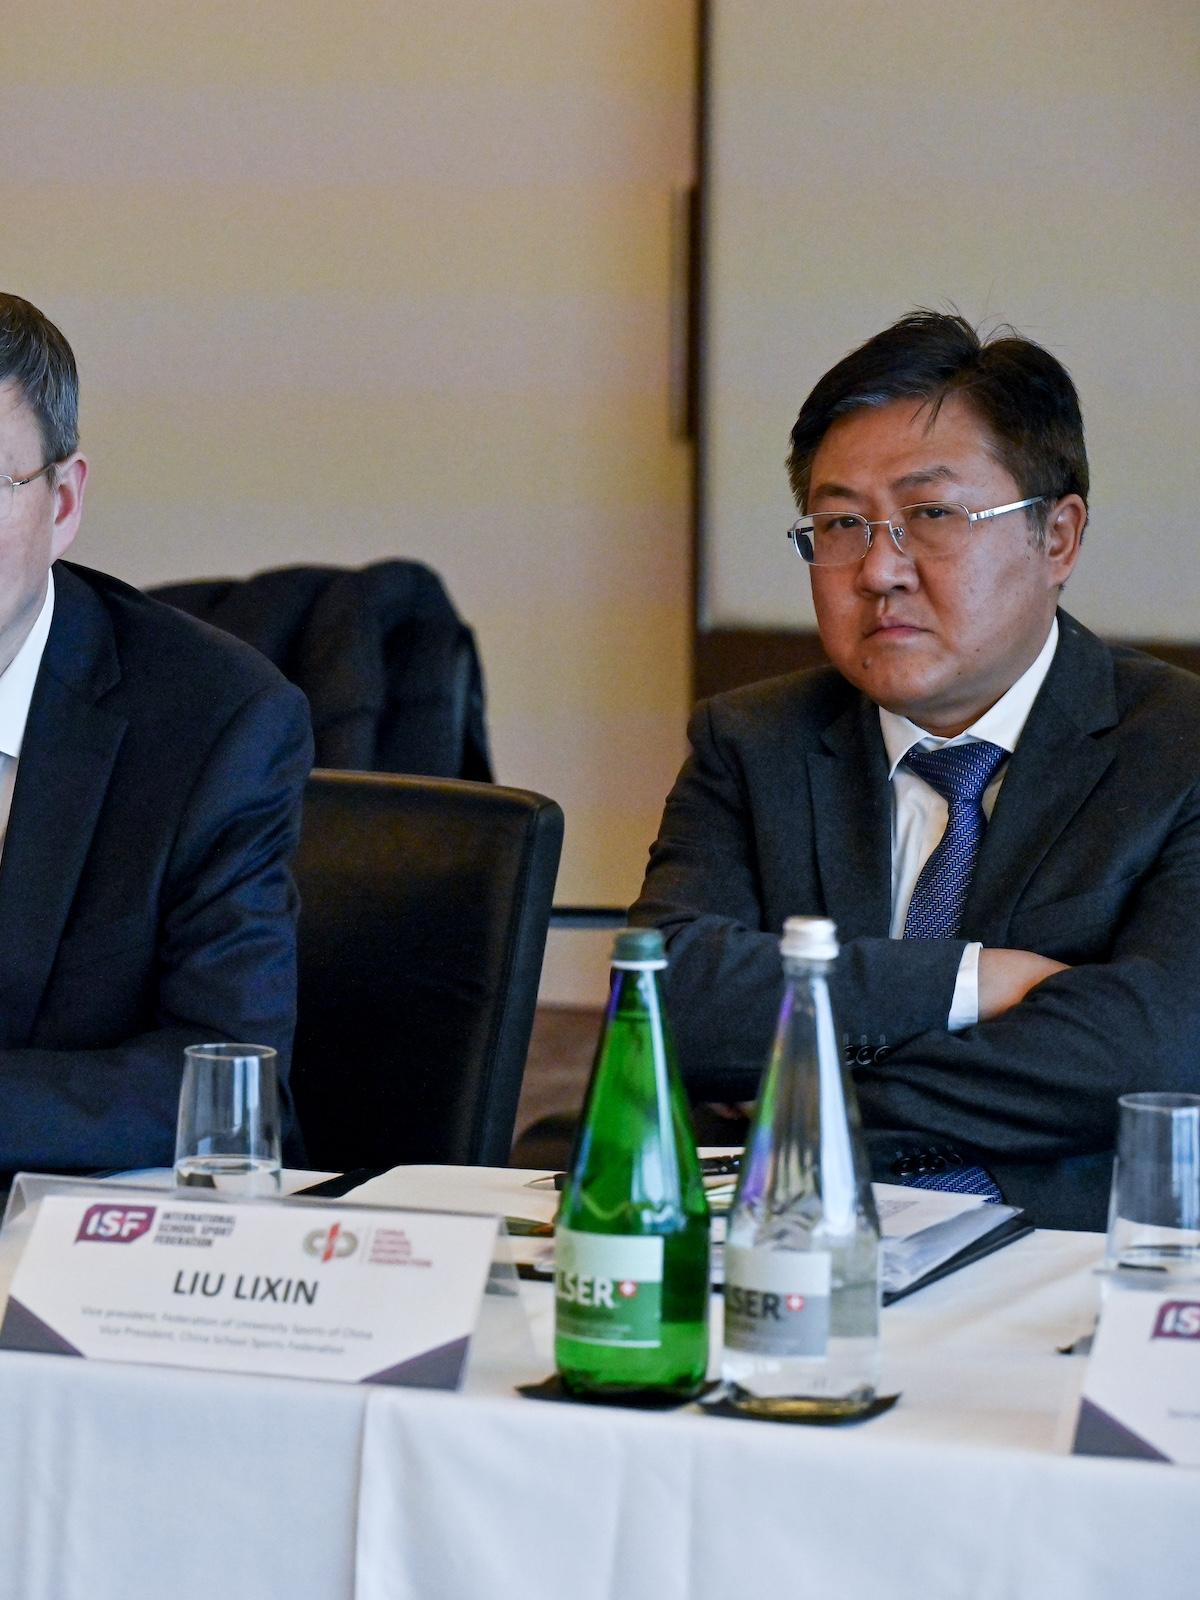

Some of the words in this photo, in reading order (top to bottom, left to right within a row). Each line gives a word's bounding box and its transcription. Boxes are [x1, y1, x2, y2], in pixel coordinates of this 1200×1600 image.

[86, 1209, 148, 1237] ISF
[173, 1269, 226, 1297] LIU
[234, 1274, 319, 1305] LIXIN
[1161, 1306, 1200, 1334] IS
